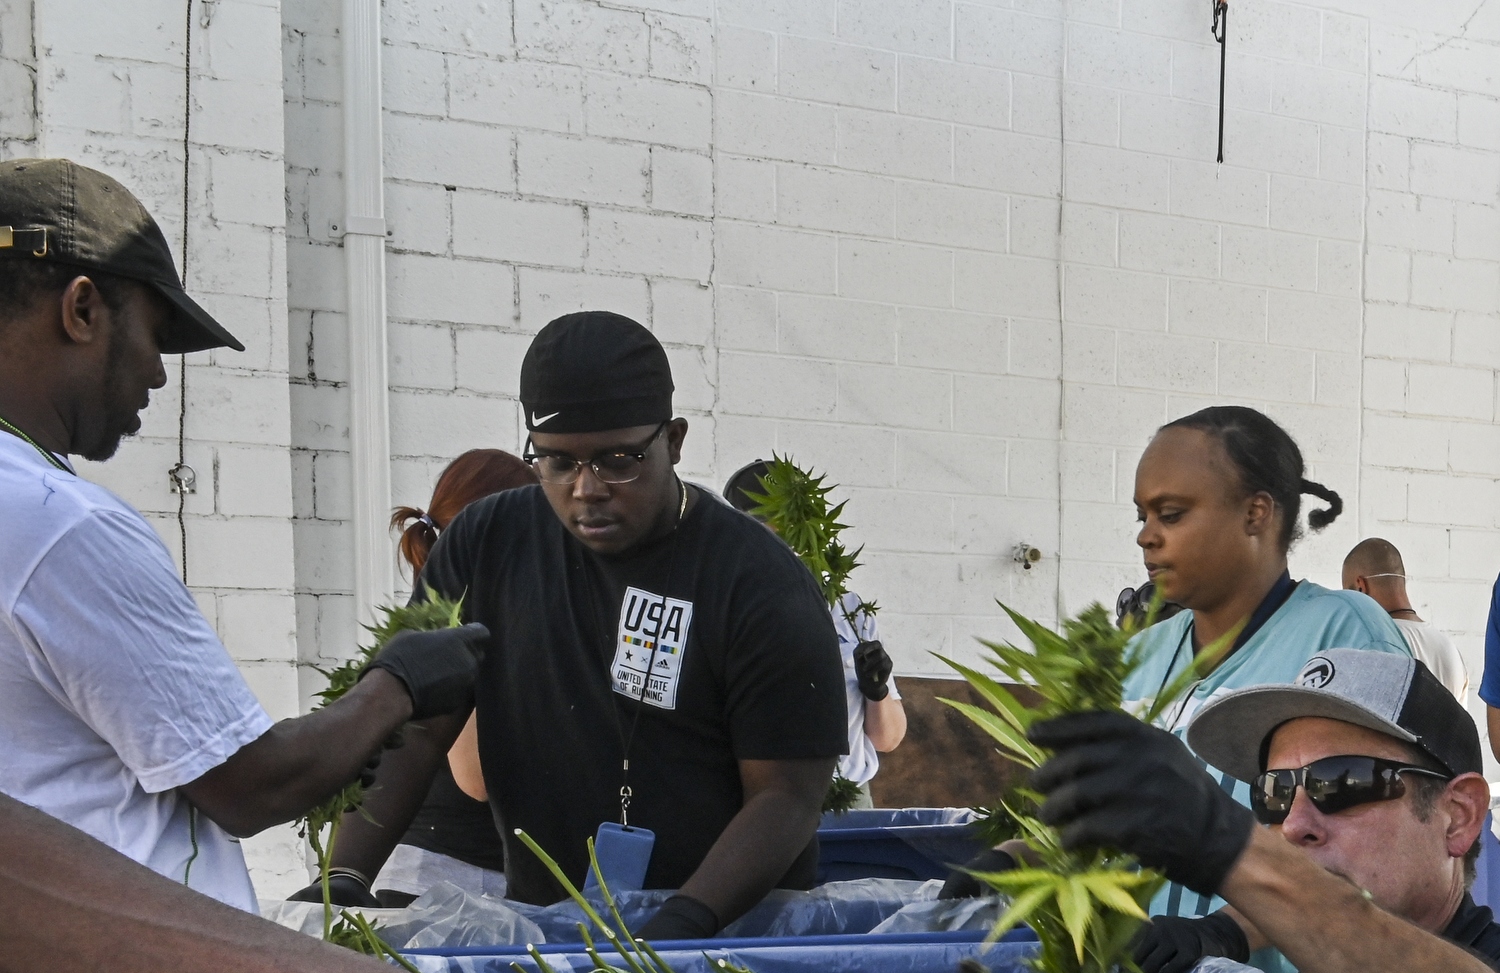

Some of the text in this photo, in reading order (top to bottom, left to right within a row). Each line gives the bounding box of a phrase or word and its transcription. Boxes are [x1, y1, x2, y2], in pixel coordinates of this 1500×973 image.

[624, 595, 684, 643] USA
[617, 670, 668, 692] UNITED TATE
[620, 682, 662, 702] OF RUNING
